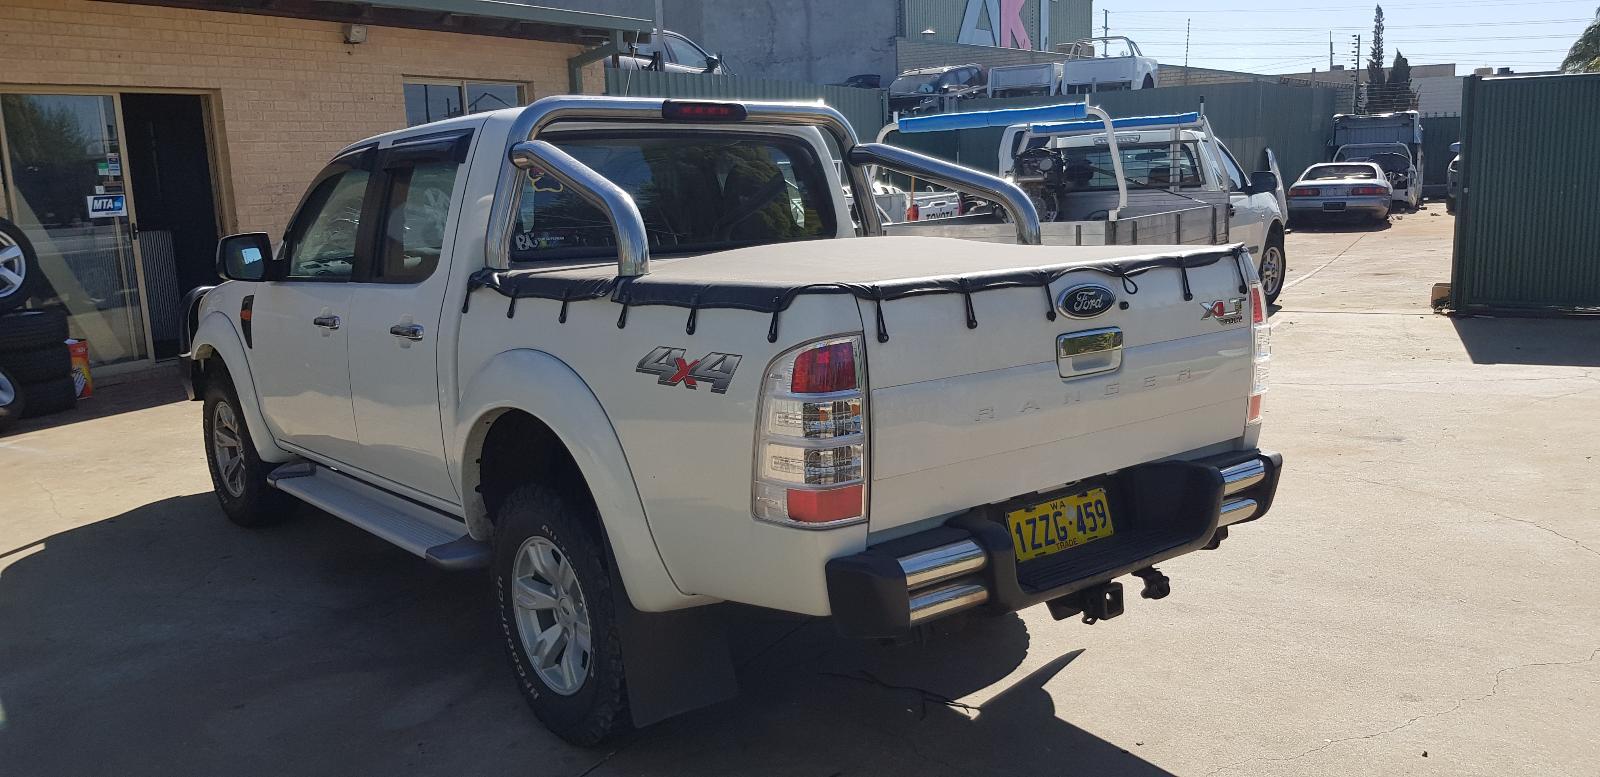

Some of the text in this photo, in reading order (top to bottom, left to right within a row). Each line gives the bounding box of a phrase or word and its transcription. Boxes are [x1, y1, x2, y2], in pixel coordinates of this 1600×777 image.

[93, 198, 114, 210] MTA
[1073, 291, 1103, 312] Ford
[1200, 297, 1246, 321] XLT
[975, 368, 1191, 422] RANGER
[1056, 537, 1079, 551] TRADE
